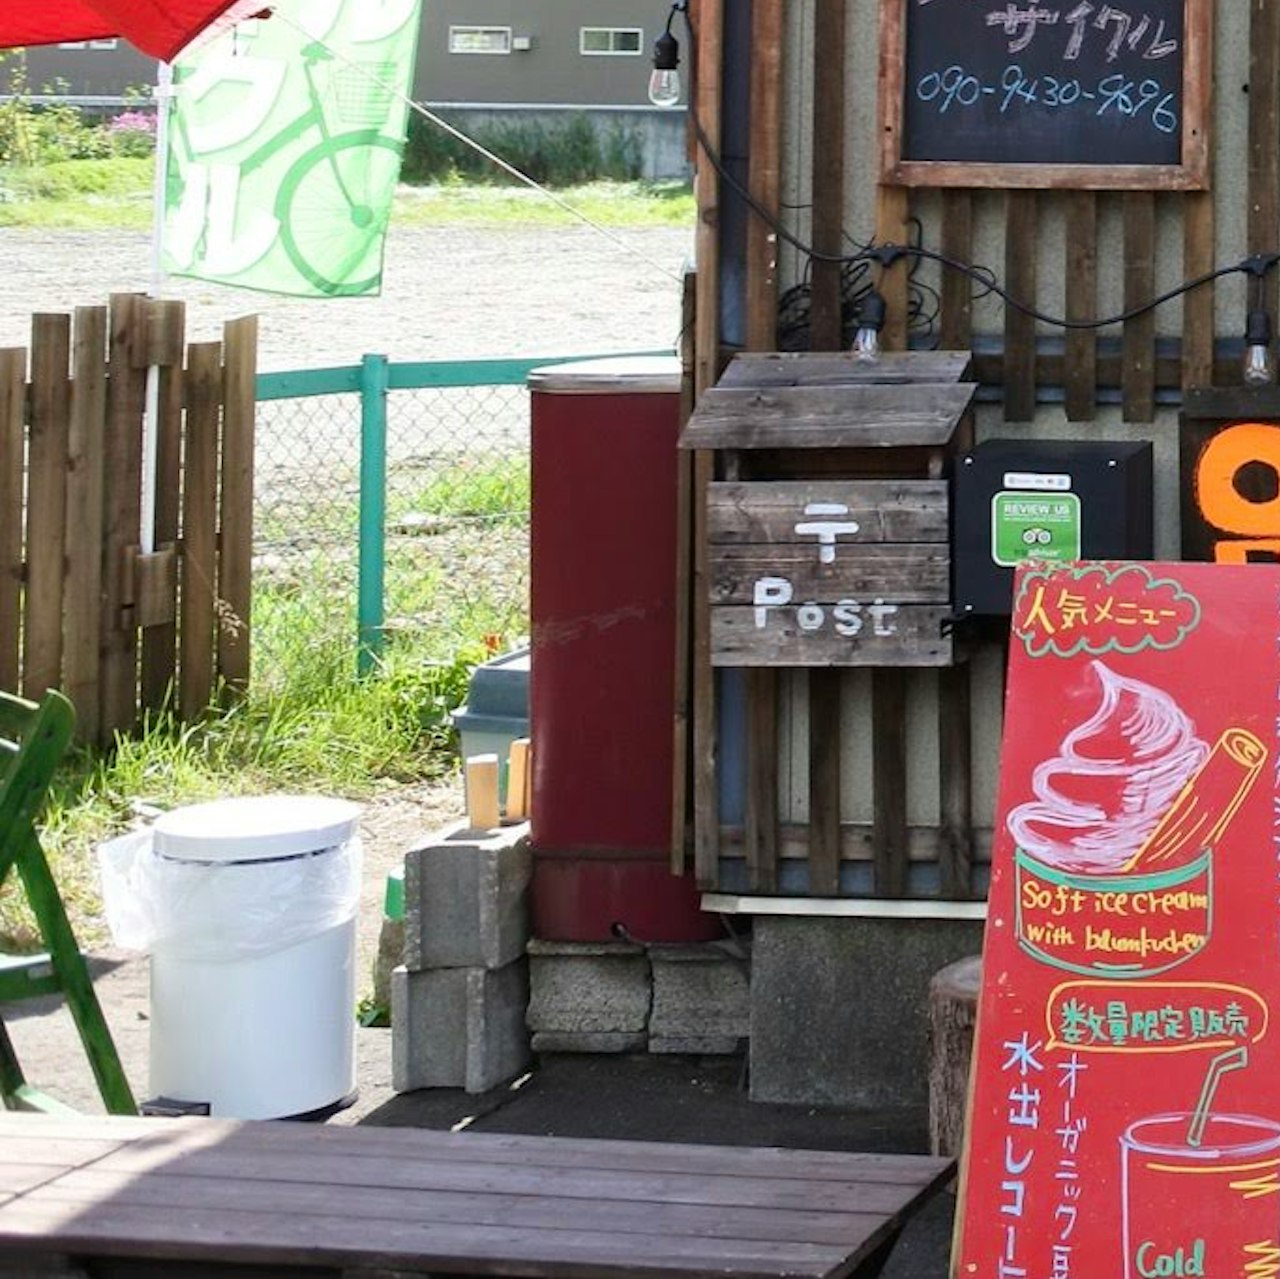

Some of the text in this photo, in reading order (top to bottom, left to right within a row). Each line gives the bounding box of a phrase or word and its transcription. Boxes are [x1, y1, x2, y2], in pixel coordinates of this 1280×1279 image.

[985, 0, 1178, 63] サイクル
[753, 577, 898, 637] Post
[1023, 585, 1177, 634] 人気メニュー
[1023, 880, 1086, 916] Soft
[1094, 891, 1129, 916] ice
[1059, 997, 1249, 1045] 数量限定販売
[1135, 1238, 1206, 1278] Cold
